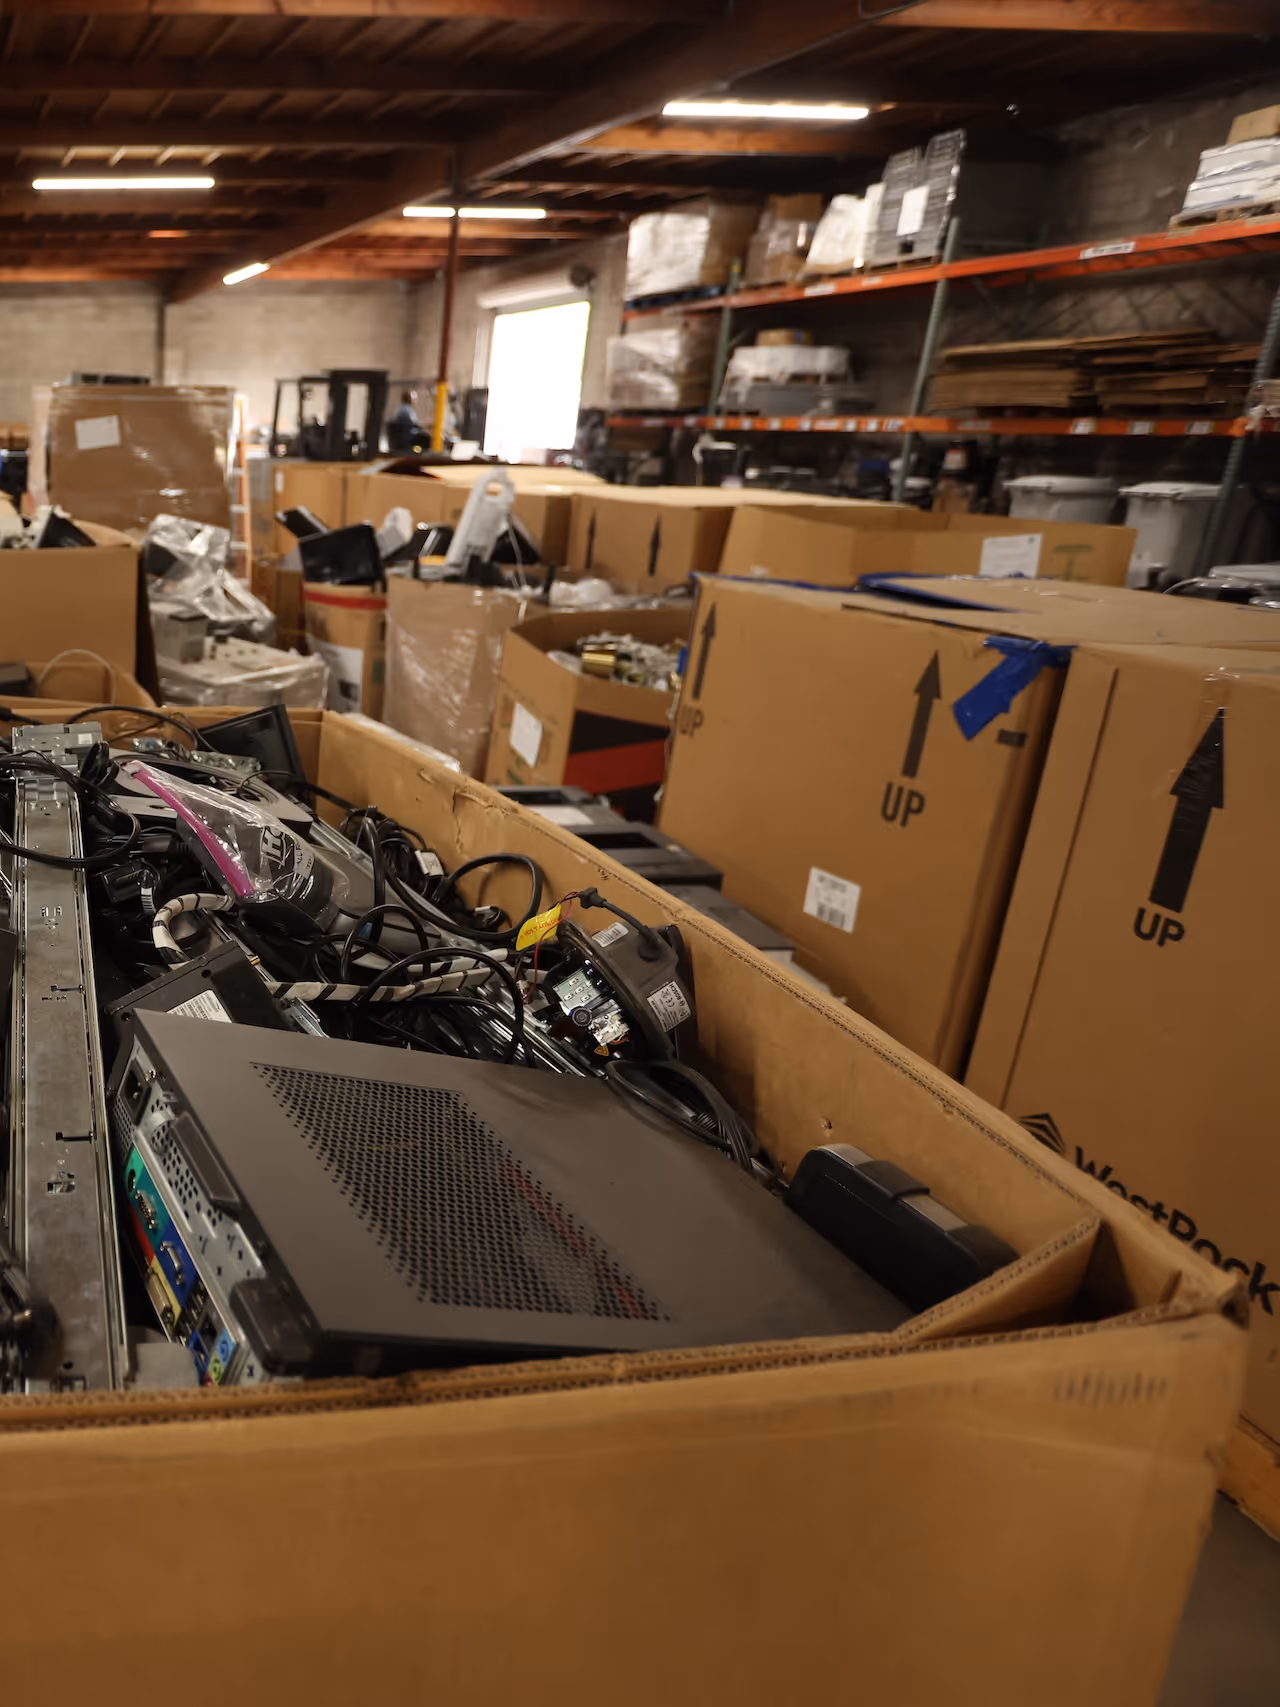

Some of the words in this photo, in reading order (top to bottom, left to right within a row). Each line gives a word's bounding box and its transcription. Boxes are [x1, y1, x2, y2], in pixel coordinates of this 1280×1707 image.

[678, 707, 705, 738] UP
[880, 782, 927, 828] UP
[1133, 908, 1187, 948] UP
[669, 983, 682, 1001] BOSCH
